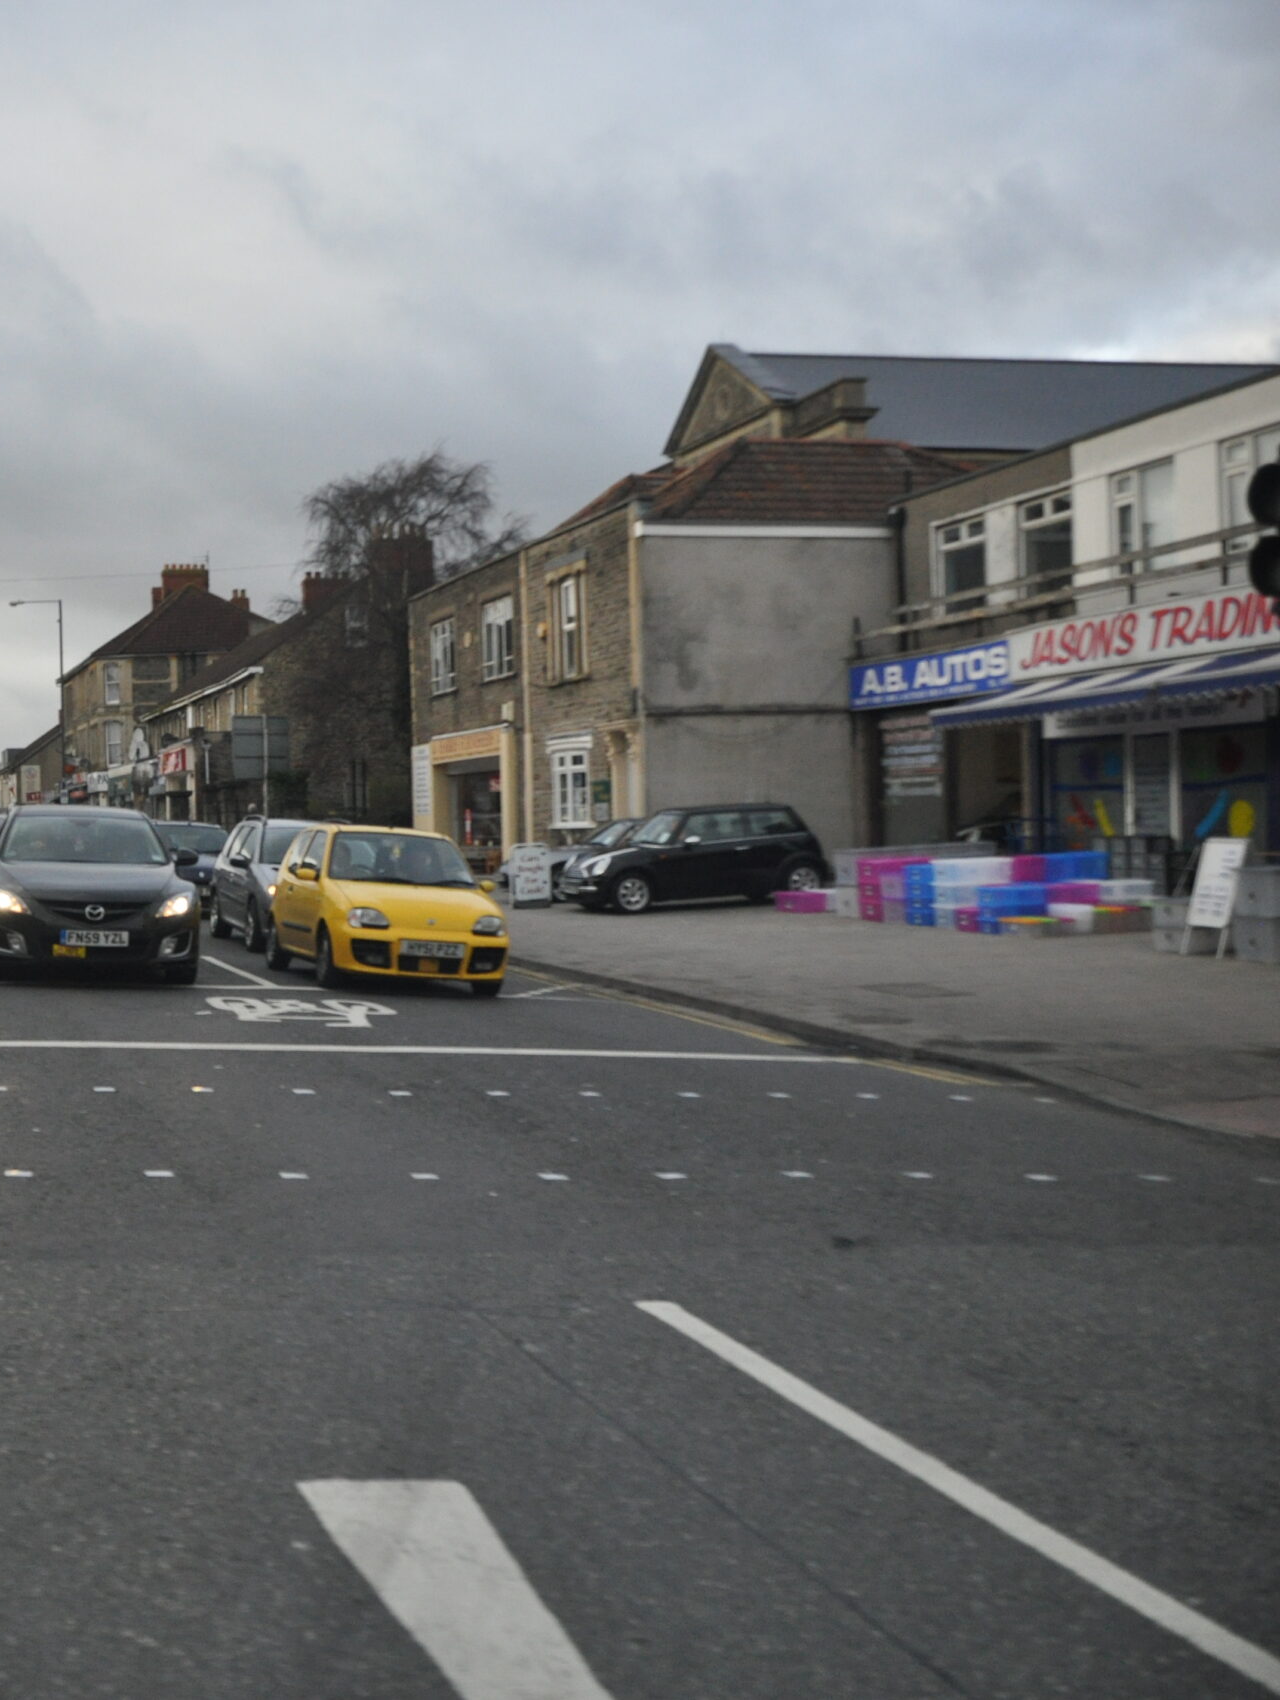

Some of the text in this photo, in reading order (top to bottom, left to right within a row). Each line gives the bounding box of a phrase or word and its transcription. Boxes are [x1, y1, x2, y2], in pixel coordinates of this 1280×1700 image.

[1151, 591, 1280, 651] TRADIN
[913, 646, 1008, 690] AUTOS
[68, 932, 126, 945] FN59 YZL
